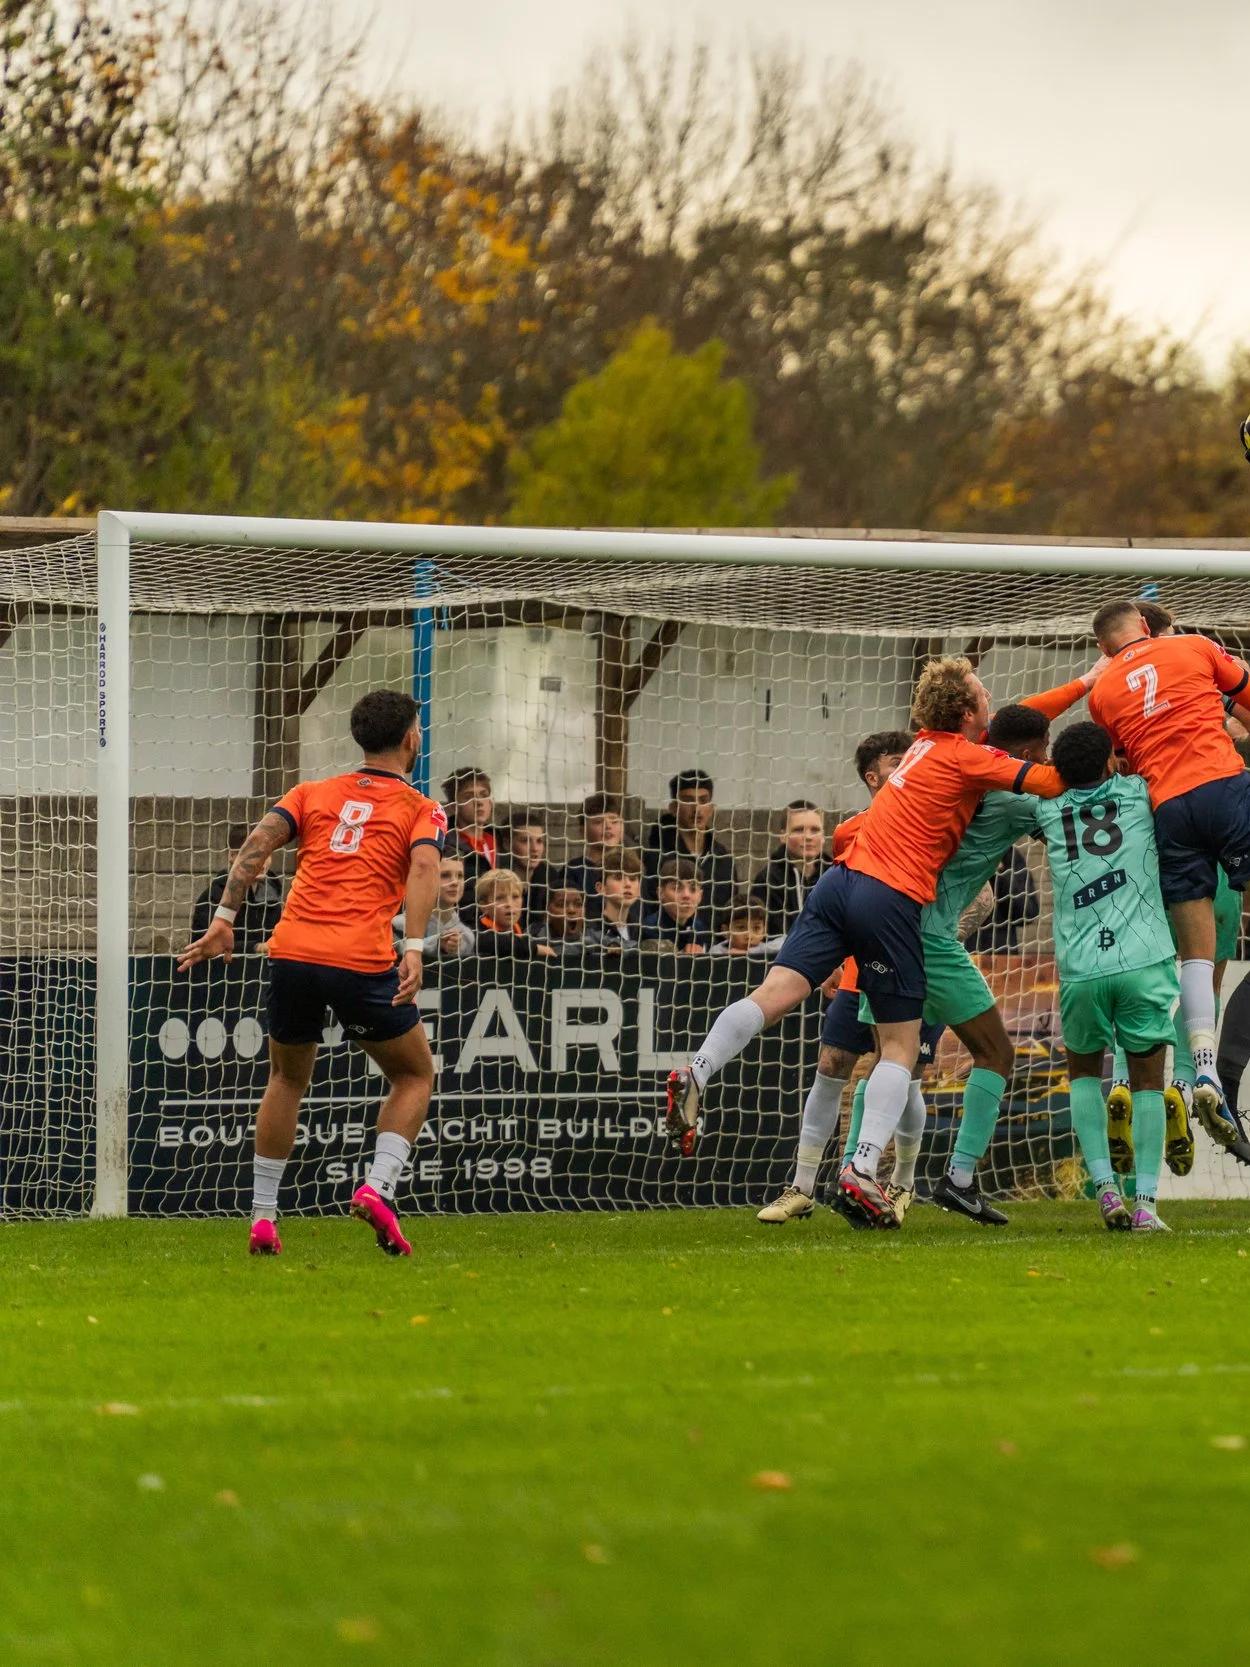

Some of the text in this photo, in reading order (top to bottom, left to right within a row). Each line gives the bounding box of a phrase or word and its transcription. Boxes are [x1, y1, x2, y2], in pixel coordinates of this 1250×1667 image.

[1126, 664, 1171, 719] 2
[330, 800, 373, 853] 8
[1061, 799, 1123, 862] 18
[1076, 872, 1122, 906] IREN
[415, 1120, 518, 1142] ACHT
[463, 1156, 553, 1180] 1998
